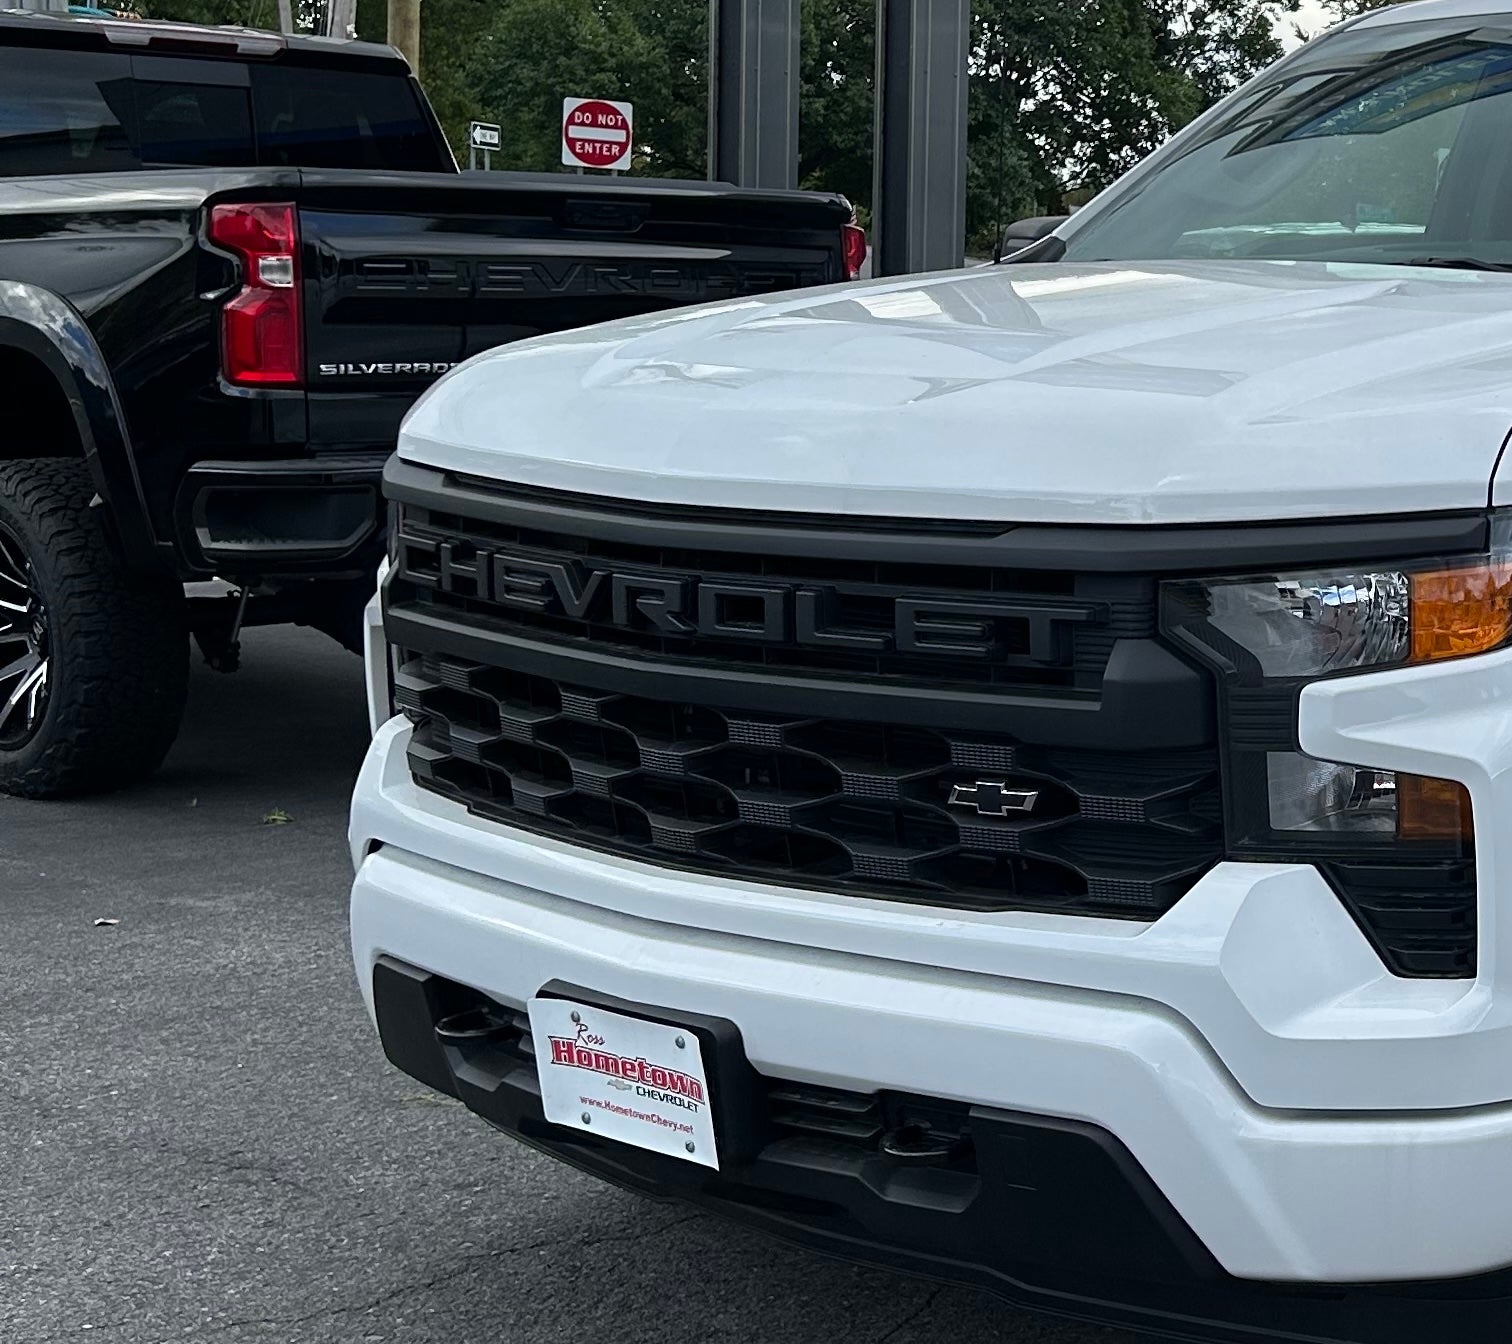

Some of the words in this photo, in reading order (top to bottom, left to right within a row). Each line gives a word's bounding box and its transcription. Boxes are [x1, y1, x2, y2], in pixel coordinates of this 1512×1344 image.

[574, 111, 592, 124] DO
[597, 113, 624, 127] NOT
[575, 141, 621, 156] ENTER
[398, 530, 1102, 664] CHEVROLET
[576, 1022, 606, 1046] Ross
[551, 1037, 705, 1103] Hometown
[636, 1085, 699, 1113] CHEVROLET
[579, 1096, 694, 1135] www.HometownChevy.net
